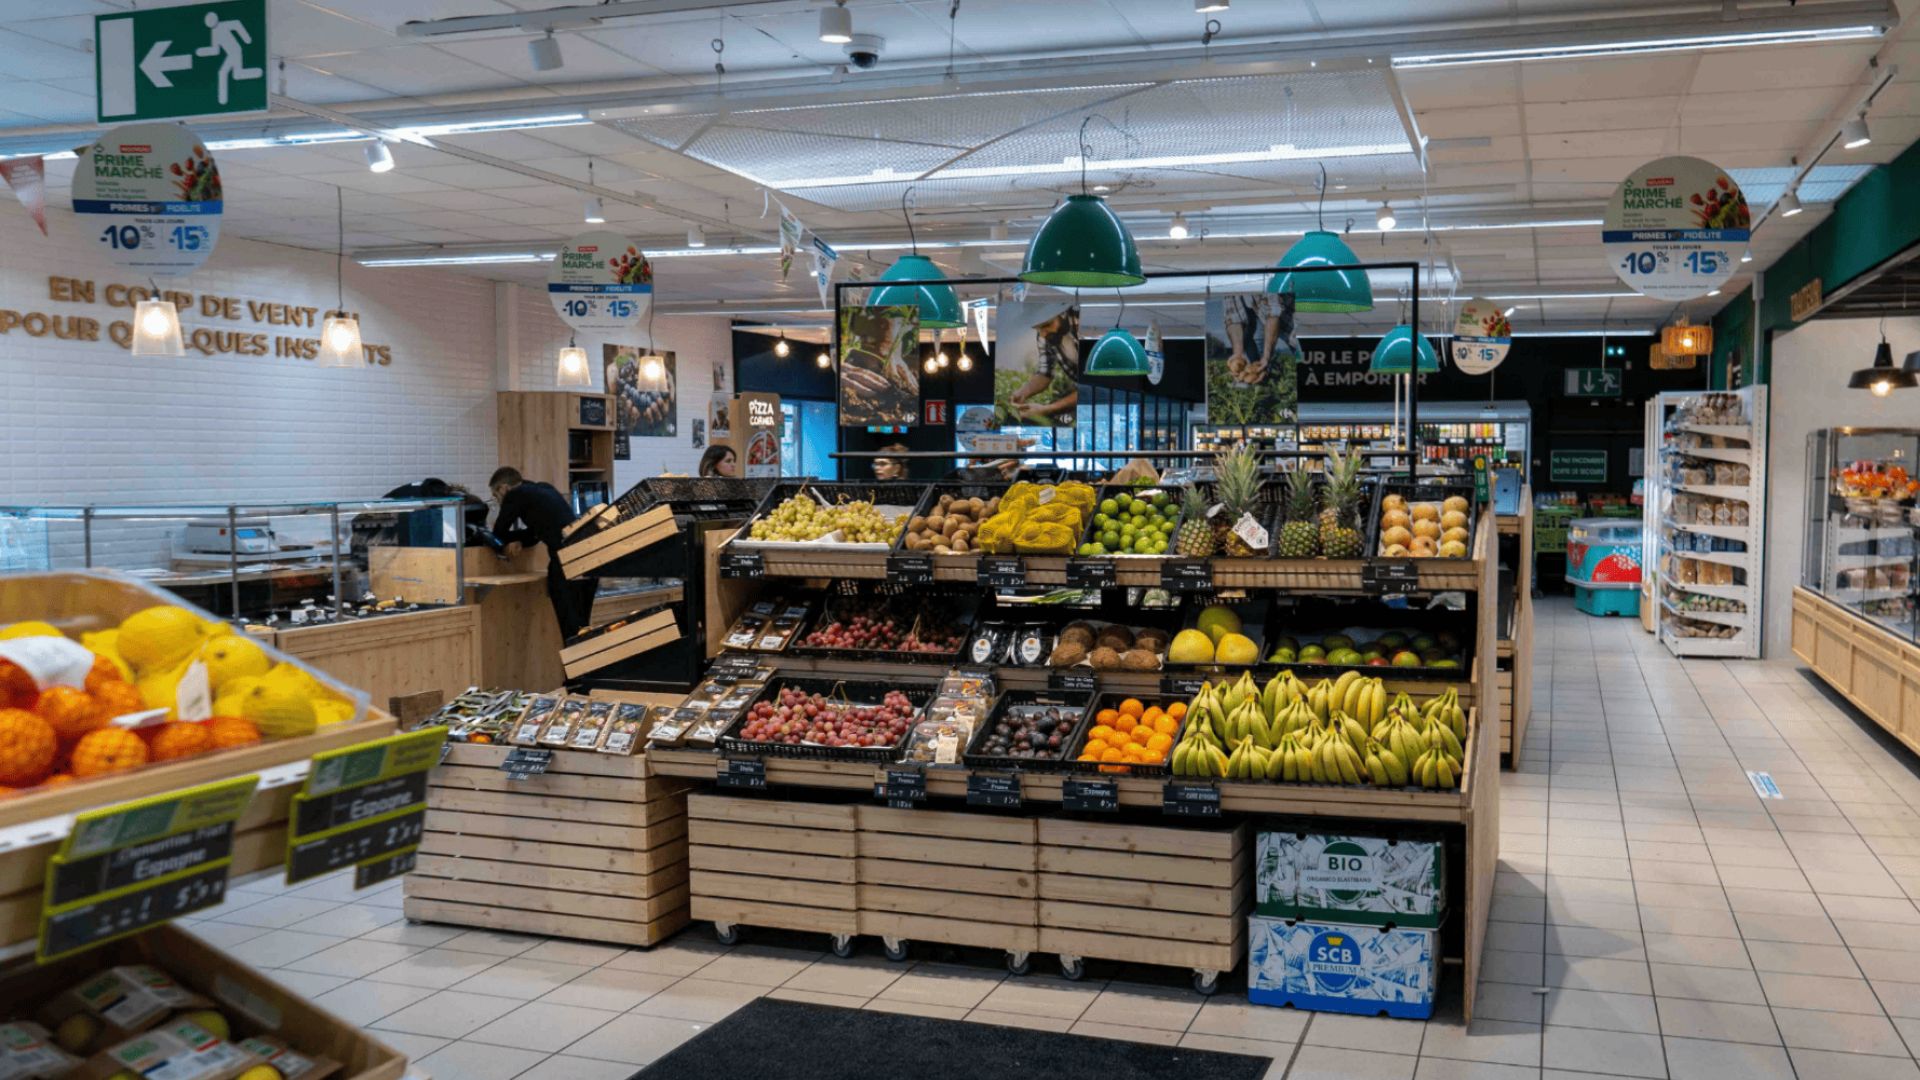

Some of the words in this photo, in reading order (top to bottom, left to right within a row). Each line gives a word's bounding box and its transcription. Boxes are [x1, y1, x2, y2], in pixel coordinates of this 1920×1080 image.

[94, 154, 144, 166] PRIME
[95, 164, 163, 179] MARCHÉ
[1624, 187, 1666, 199] PRIME
[1623, 196, 1683, 209] MARCHÉ
[1632, 231, 1666, 240] PRIMES
[1621, 251, 1669, 274] -10%
[1683, 251, 1729, 274] -15%
[48, 275, 96, 304] EN
[200, 295, 241, 321] DE
[247, 300, 319, 328] VENT
[0, 309, 100, 341] POUR
[275, 335, 392, 367] INSTS
[1301, 351, 1326, 364] UR
[1331, 351, 1353, 364] LE
[1305, 367, 1319, 386] À
[749, 415, 775, 426] CORNER
[351, 791, 413, 820] Espagne
[133, 848, 207, 880] Espagne
[1328, 856, 1363, 872] BIO
[1317, 948, 1353, 963] SCB
